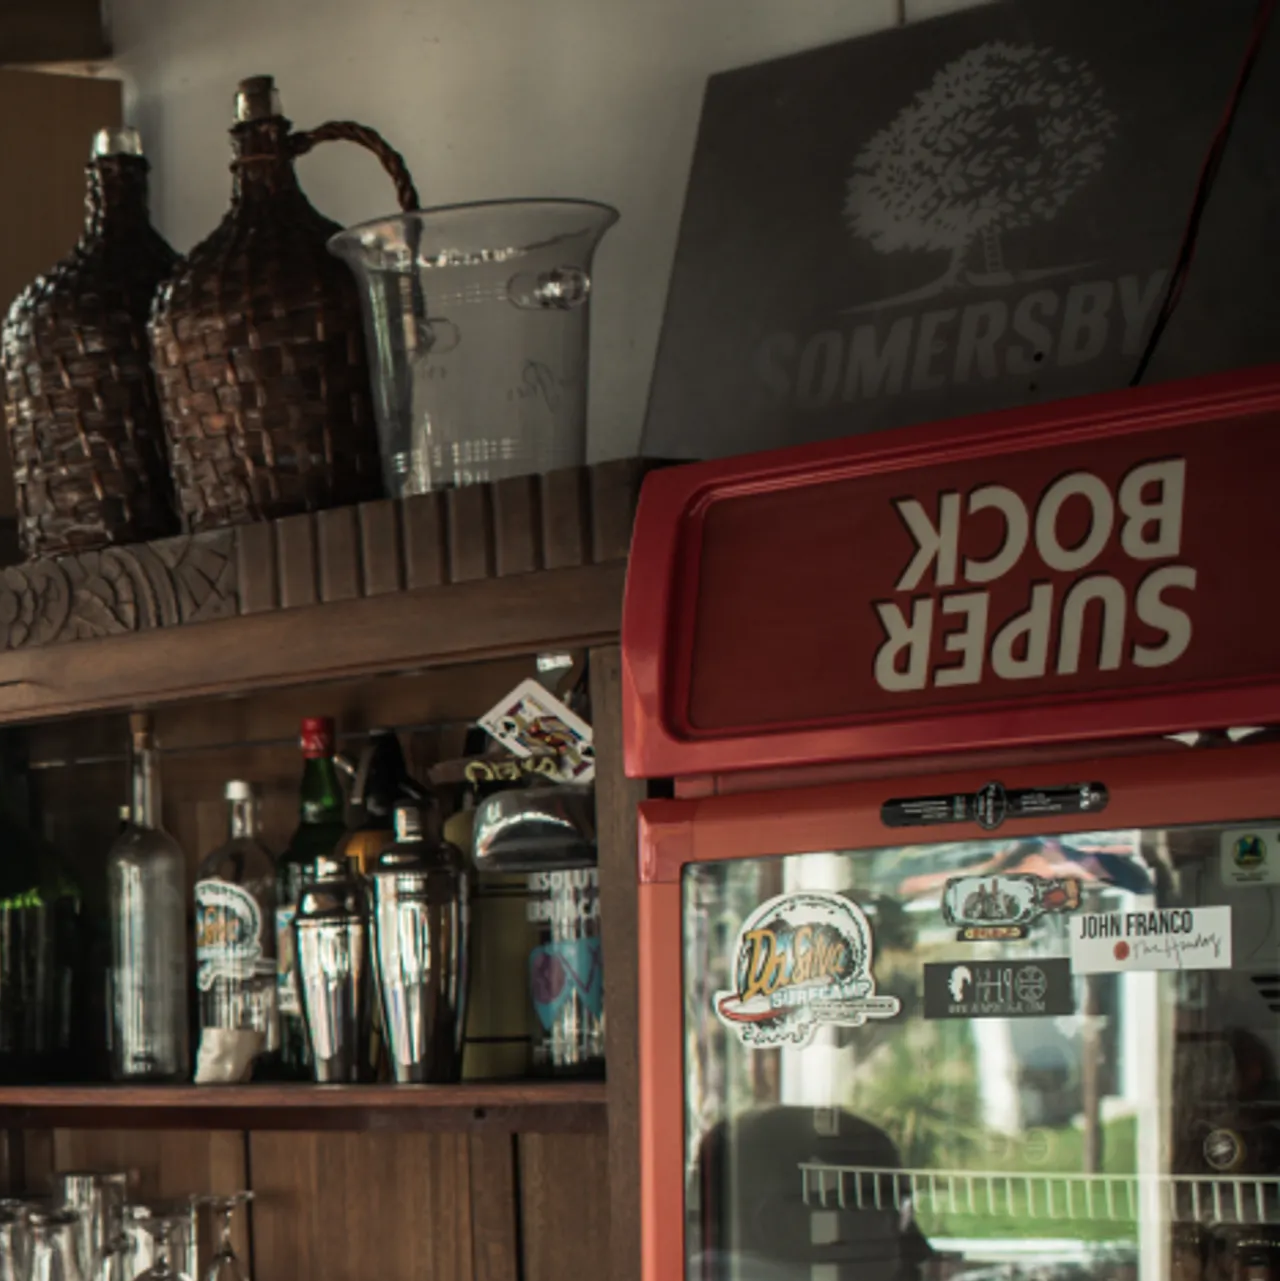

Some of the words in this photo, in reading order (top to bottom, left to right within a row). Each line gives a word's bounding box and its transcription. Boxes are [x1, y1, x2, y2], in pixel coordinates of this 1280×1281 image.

[753, 270, 1168, 402] SOMERSBY
[894, 457, 1187, 592] BOCK
[873, 565, 1198, 693] SUPER
[741, 929, 791, 1004] Da
[1079, 915, 1121, 940] JOHN
[1125, 910, 1194, 937] FRANCO
